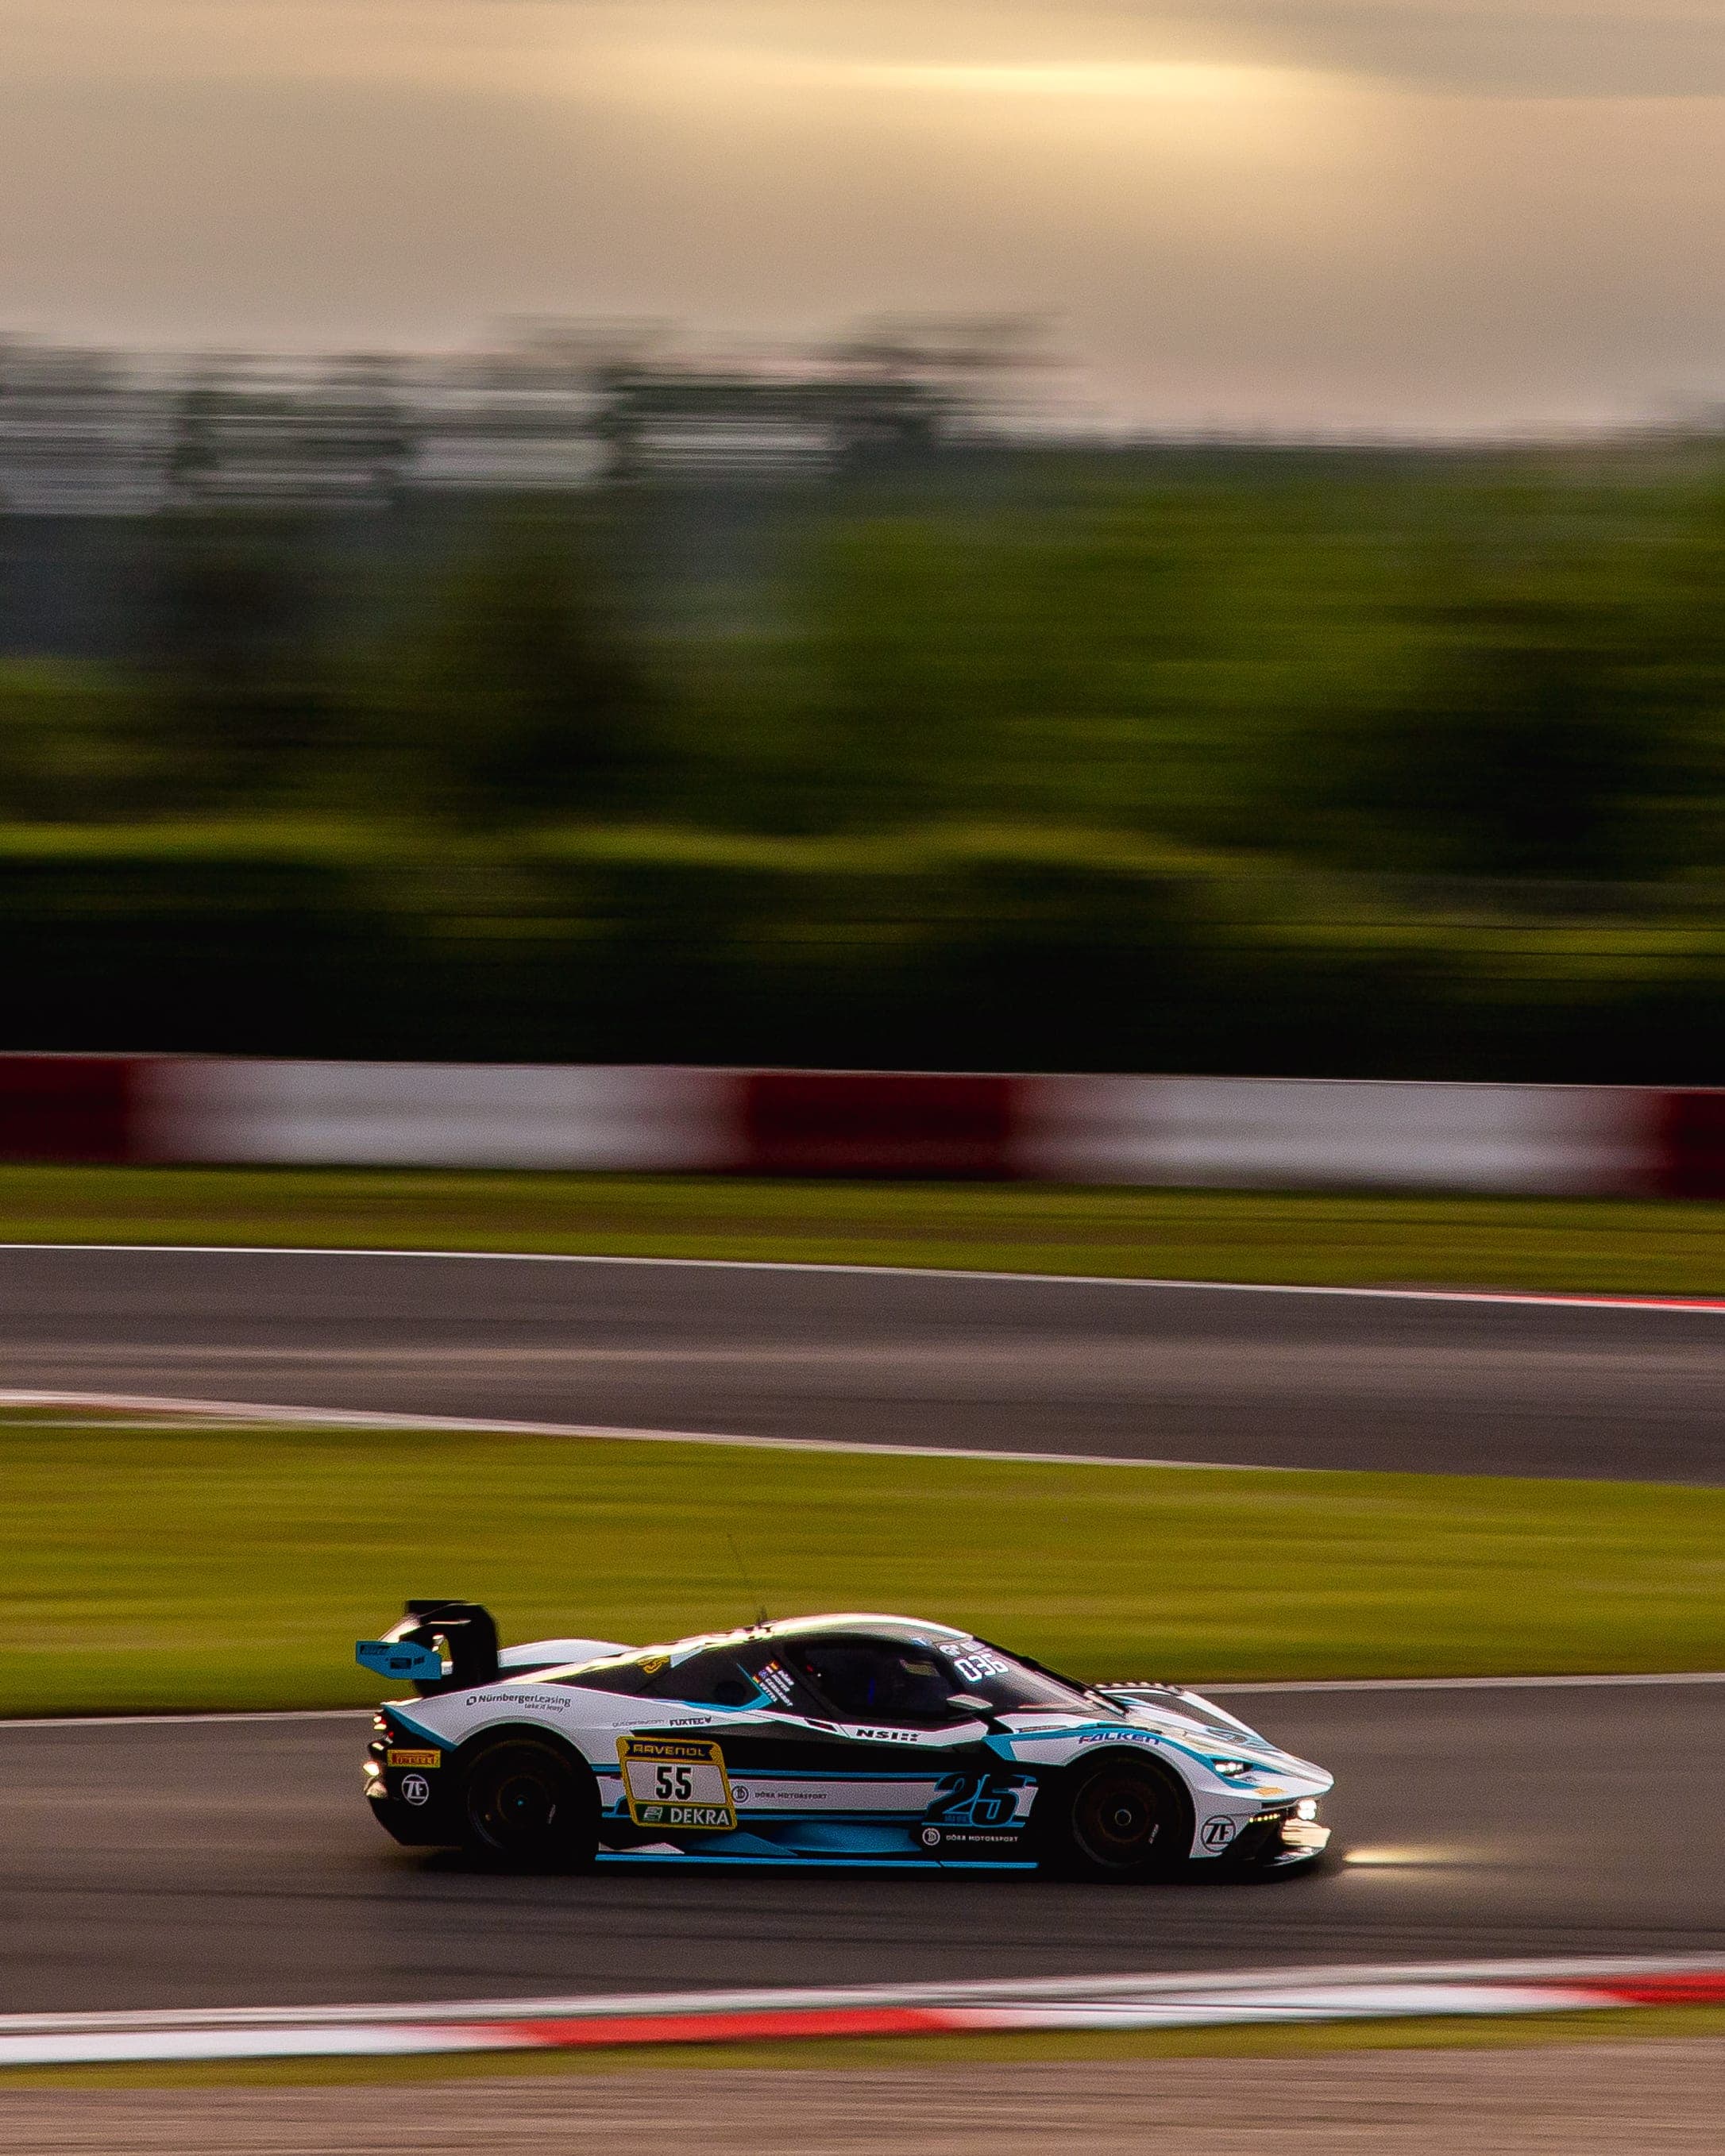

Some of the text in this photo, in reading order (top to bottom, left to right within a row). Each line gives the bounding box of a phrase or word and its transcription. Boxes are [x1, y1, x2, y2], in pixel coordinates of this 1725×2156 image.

[954, 1653, 1009, 1682] 036
[670, 1718, 704, 1726] FUXTEC
[1079, 1732, 1160, 1745] FALKEN
[633, 1744, 706, 1757] RAVENOL
[403, 1780, 428, 1800] ZF
[655, 1766, 693, 1801] 55
[670, 1807, 730, 1826] DEKRA
[1204, 1822, 1234, 1846] ZF
